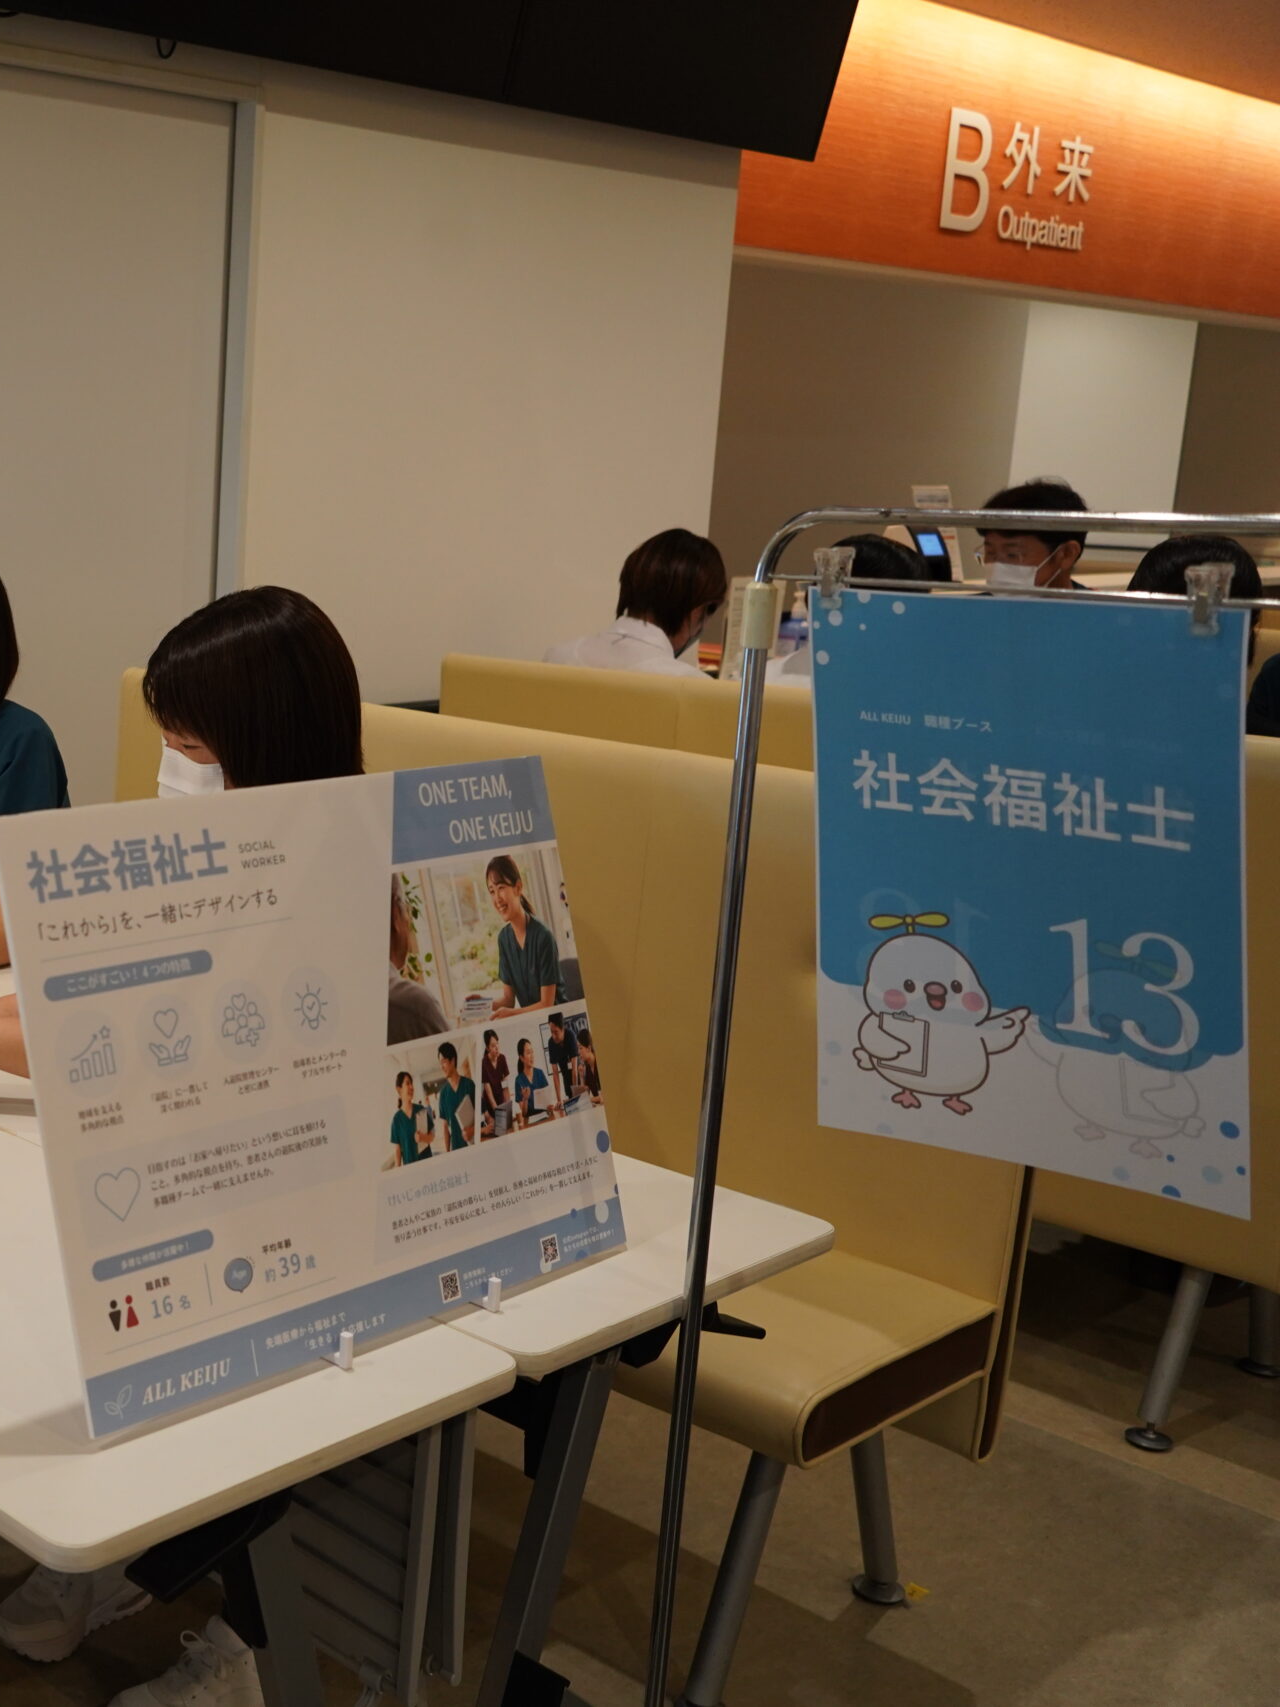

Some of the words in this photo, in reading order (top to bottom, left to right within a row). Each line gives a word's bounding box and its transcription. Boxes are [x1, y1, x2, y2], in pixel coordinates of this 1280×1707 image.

[939, 106, 993, 233] B
[1001, 121, 1096, 204] 外来
[997, 204, 1085, 251] Outpatient
[859, 710, 880, 723] ALL
[881, 712, 912, 726] KEIJU
[923, 713, 993, 734] 職種ブース
[418, 779, 458, 808] ONE
[458, 773, 512, 802] TEAM,
[852, 748, 1195, 853] 社会福祉士
[449, 816, 488, 845] ONE
[488, 809, 534, 839] KEIJU
[238, 839, 276, 854] SOCIAL
[241, 854, 287, 870] WORKER
[26, 828, 229, 904] 社会福祉士
[37, 888, 279, 942] 「これから」を、一緒にデザインする
[1049, 918, 1201, 1058] 13
[261, 1238, 292, 1255] 平均年齢
[278, 1253, 301, 1279] 39
[145, 1276, 171, 1292] 職員数
[151, 1295, 174, 1320] 16
[179, 1295, 191, 1310] 名
[141, 1379, 176, 1406] ALL
[179, 1358, 232, 1393] KEIJU
